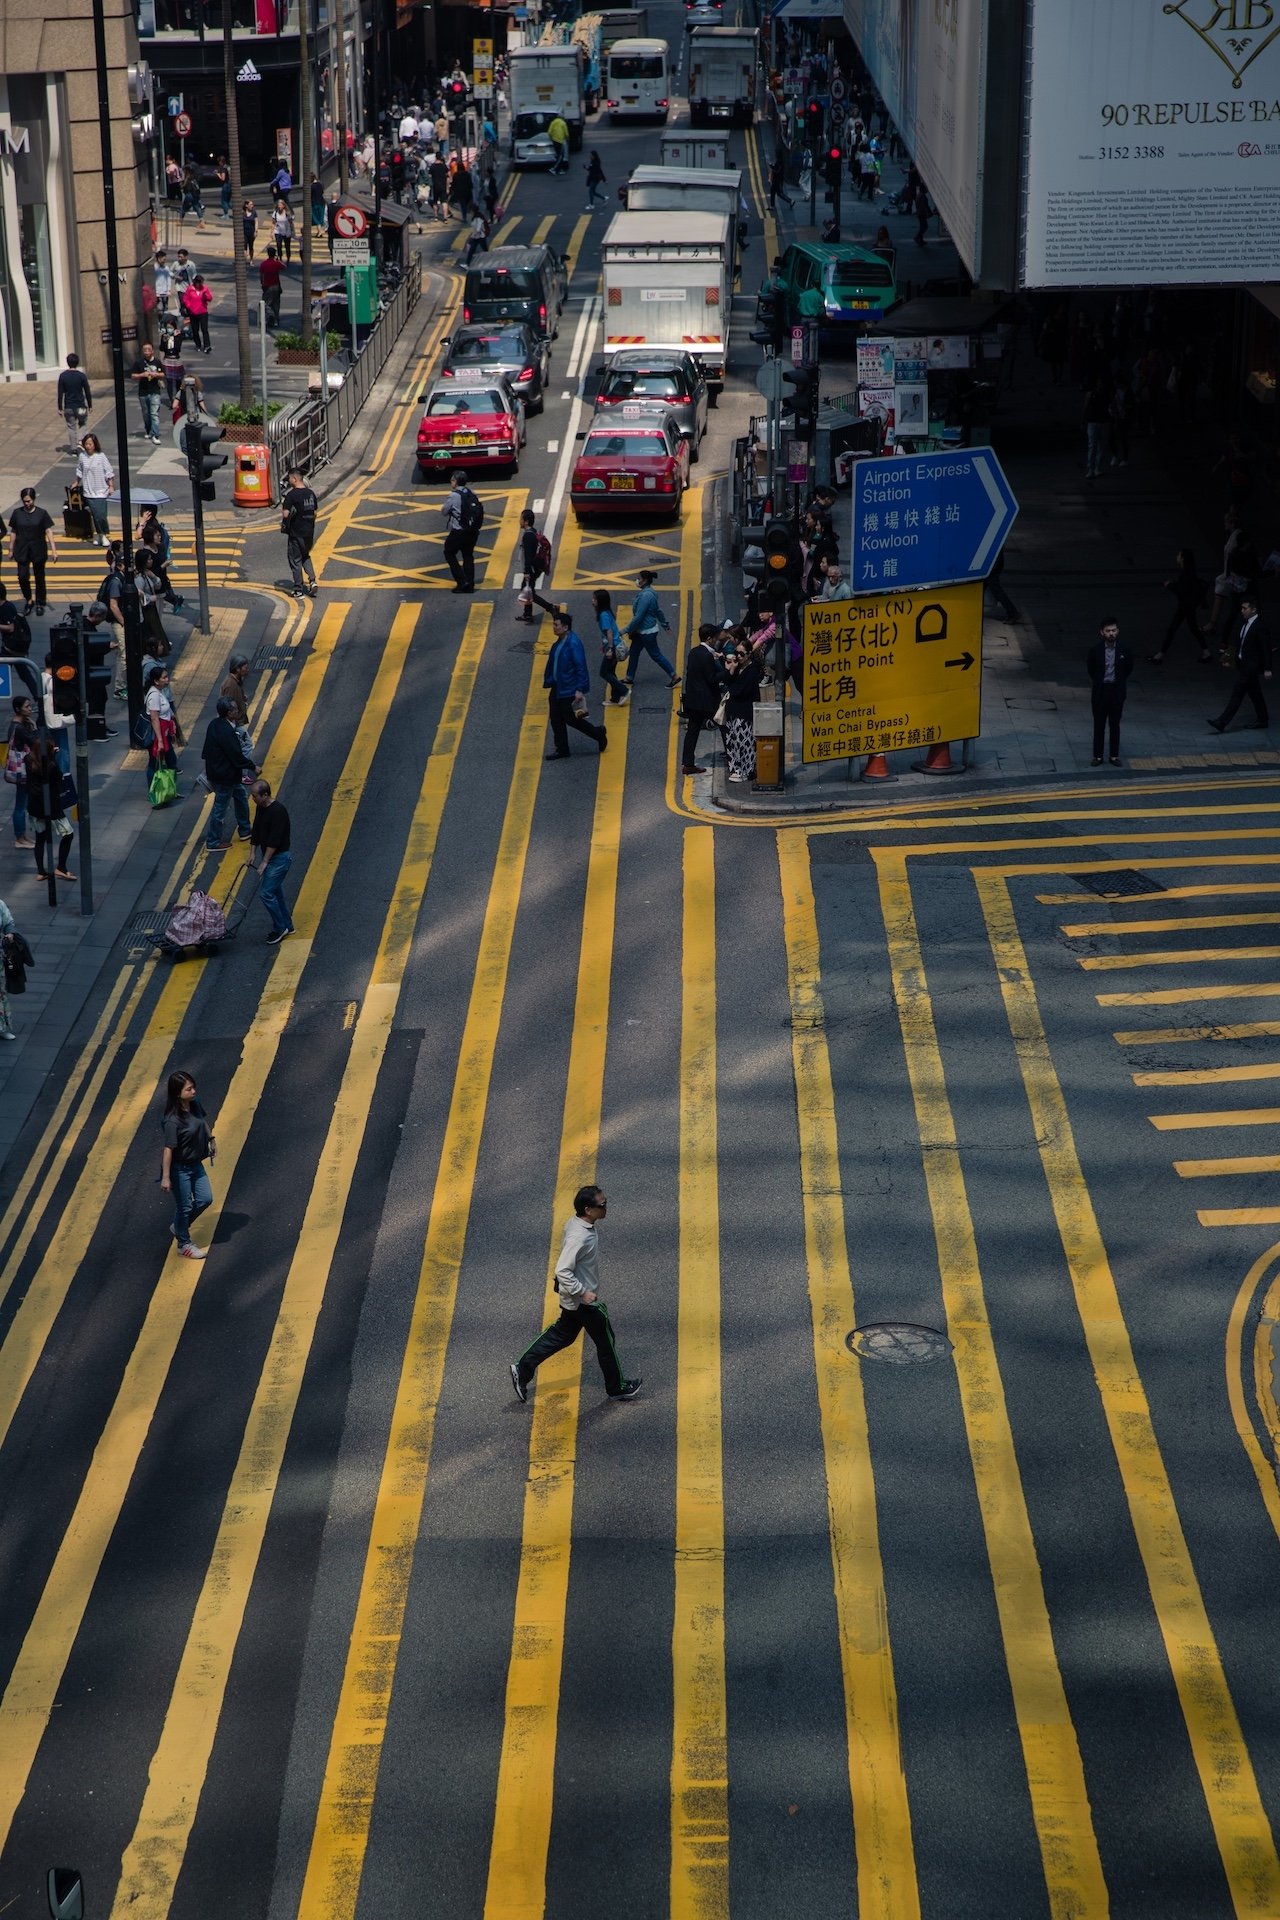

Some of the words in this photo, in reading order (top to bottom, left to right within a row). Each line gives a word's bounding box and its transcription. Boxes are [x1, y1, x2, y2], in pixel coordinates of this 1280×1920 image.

[1102, 104, 1129, 127] 90
[1132, 101, 1246, 125] REPULSE
[1099, 146, 1129, 160] 3152
[1134, 146, 1165, 159] 3388
[863, 468, 910, 486] Airport
[916, 463, 970, 481] Express
[863, 487, 911, 504] Station
[863, 504, 960, 533] 機場快綫站
[861, 534, 918, 551] Kowloon
[862, 558, 898, 580] 九龍
[811, 611, 841, 626] Wan
[848, 604, 878, 621] Chai
[886, 599, 913, 618] (N)
[810, 622, 898, 656] 灣仔(北)
[810, 658, 850, 675] North
[858, 652, 894, 669] Point
[810, 675, 856, 704] 北角
[811, 712, 831, 724] (via
[836, 706, 875, 720] Central
[811, 726, 833, 737] Wan
[839, 722, 862, 734] Chai
[867, 714, 909, 730] Bypass)
[810, 726, 942, 758] (經中環及灣仔繞道)
